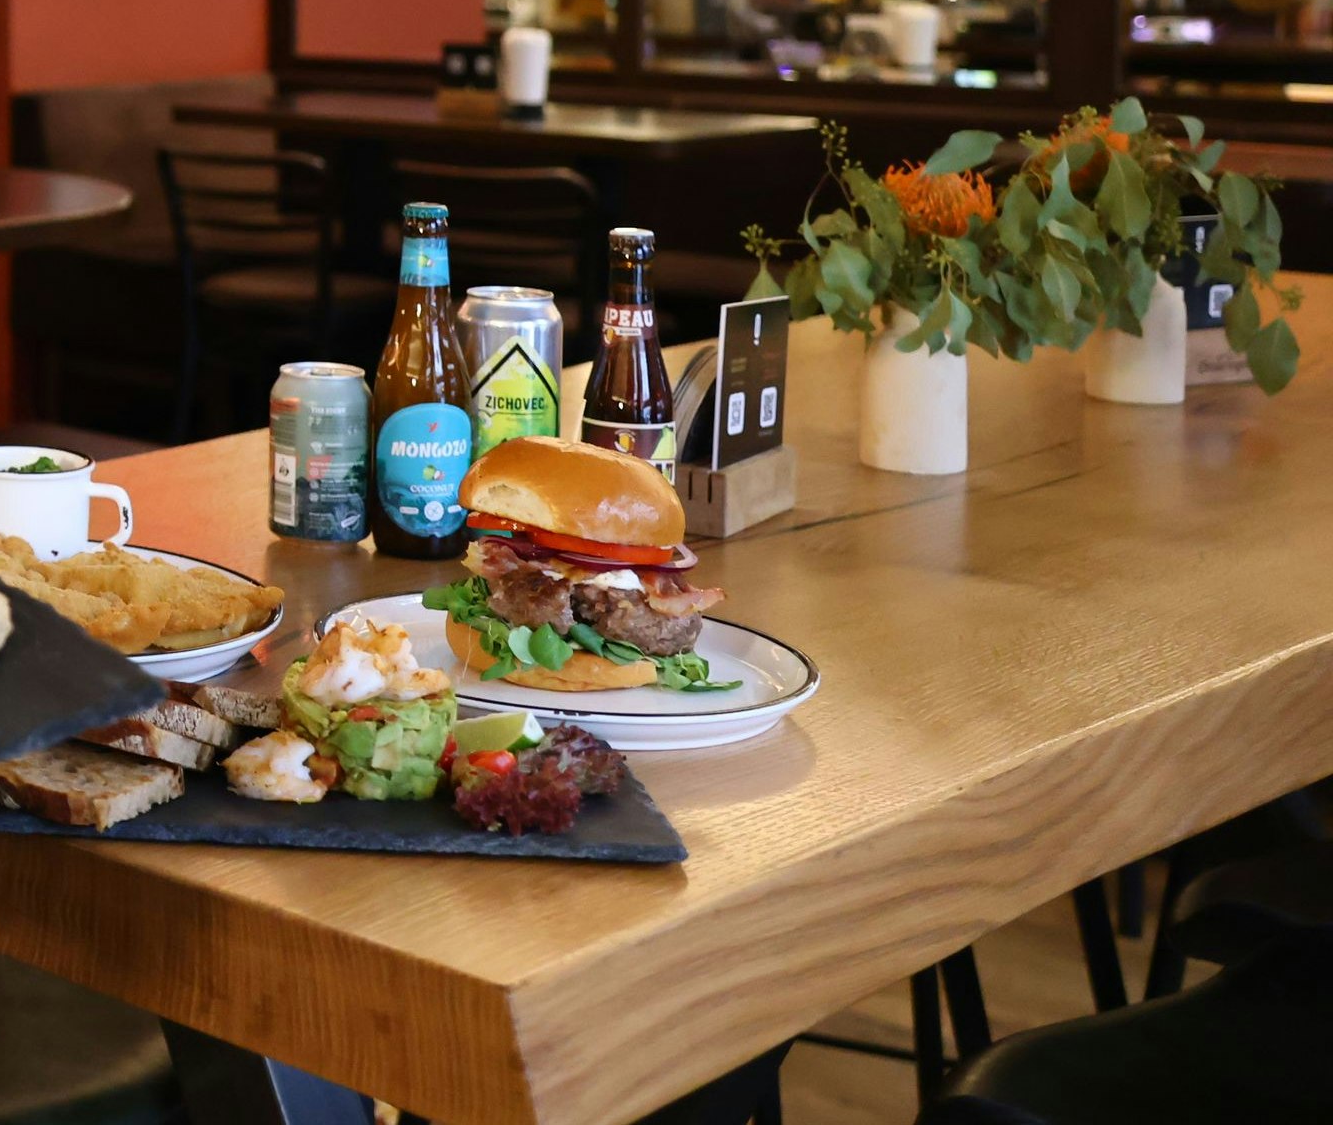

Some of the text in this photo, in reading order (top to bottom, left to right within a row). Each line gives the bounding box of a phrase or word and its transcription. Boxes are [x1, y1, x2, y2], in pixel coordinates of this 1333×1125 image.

[485, 395, 546, 411] ZICHOVEC
[391, 438, 468, 458] MONGOZO
[409, 483, 455, 493] COCONUT
